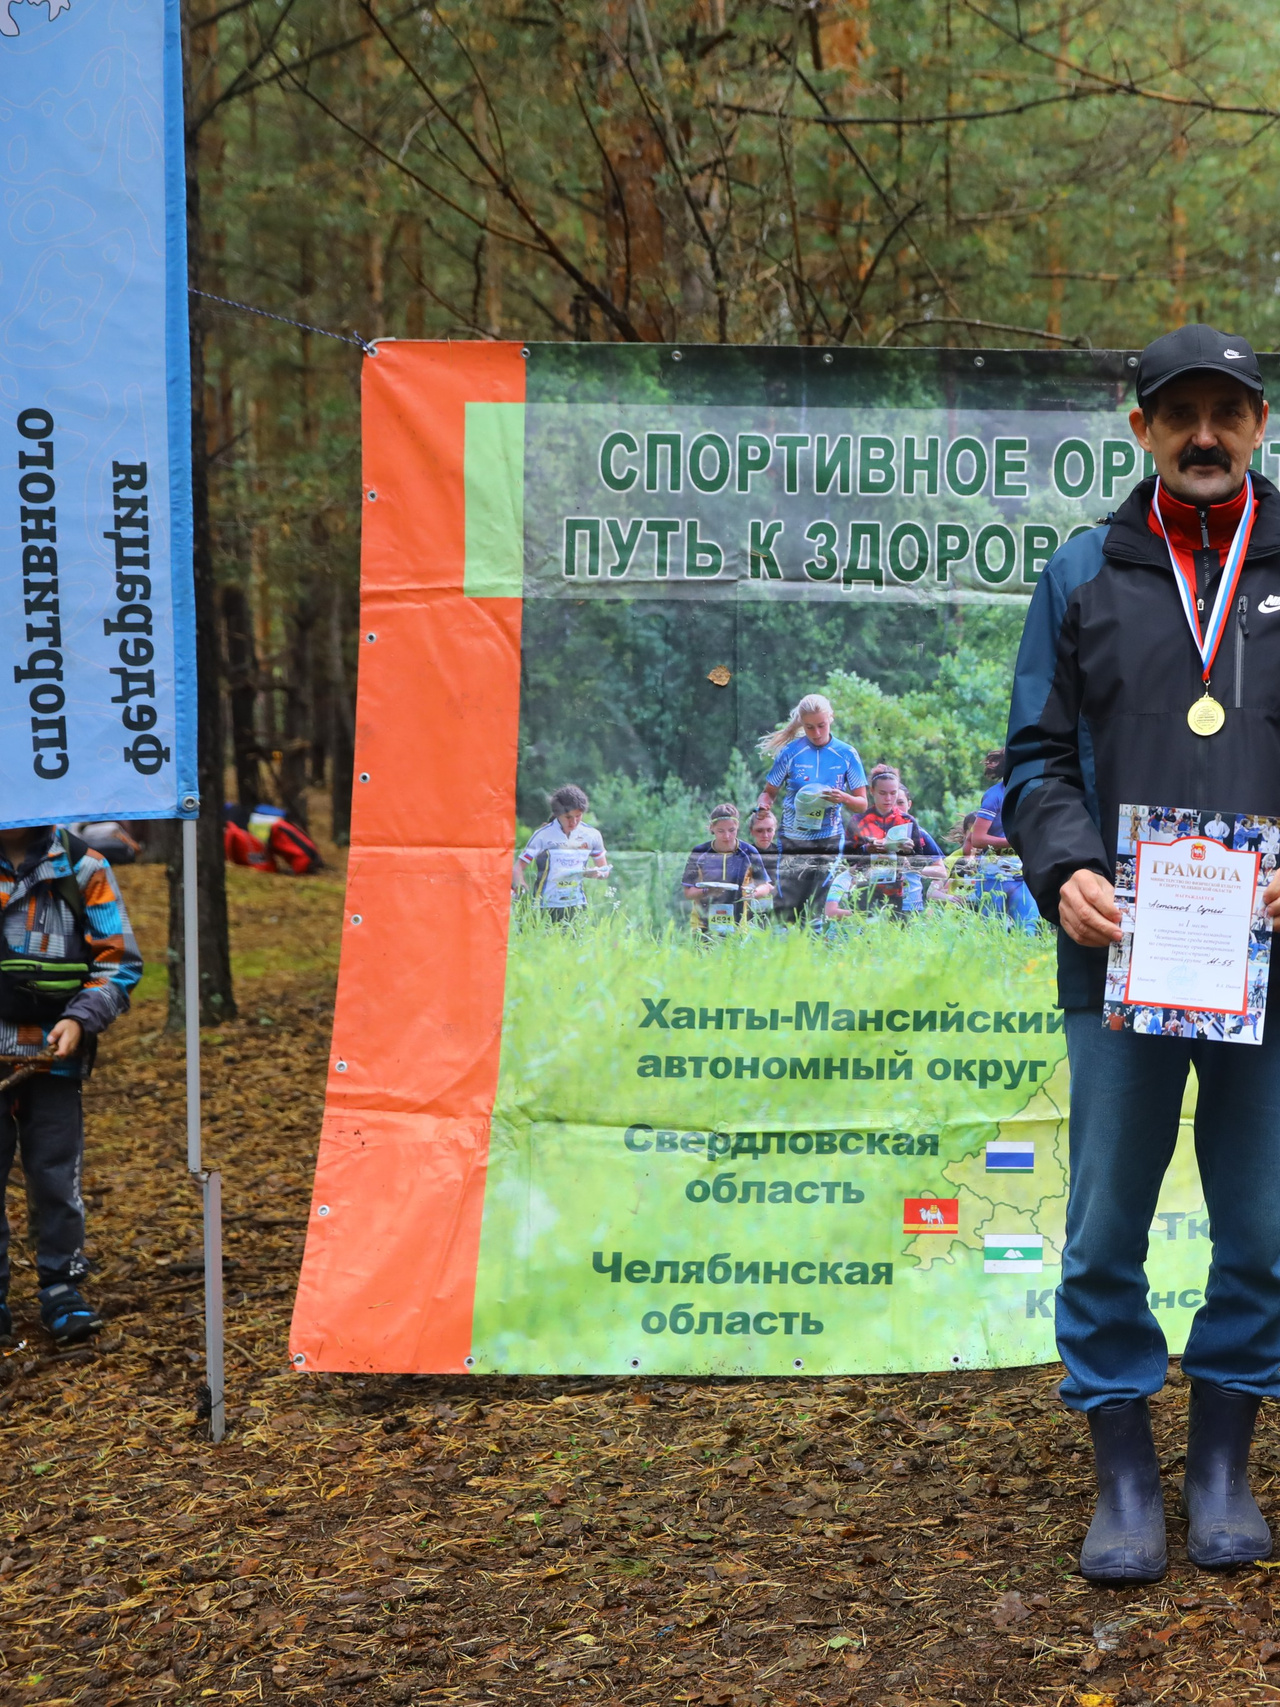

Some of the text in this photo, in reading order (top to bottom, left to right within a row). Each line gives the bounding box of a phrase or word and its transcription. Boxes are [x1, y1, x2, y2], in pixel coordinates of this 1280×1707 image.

[599, 430, 1030, 498] СПОРТИВНОЕ
[562, 516, 725, 580] ПУТЬ
[748, 520, 783, 580] К
[1151, 860, 1241, 881] ГРАМОТА
[638, 998, 1066, 1035] Ханты-Мансийский
[636, 1050, 1047, 1090] автономный округ
[623, 1122, 940, 1162] Свердловская
[685, 1171, 866, 1205] область
[592, 1251, 894, 1287] Челябинская
[641, 1302, 824, 1336] область
